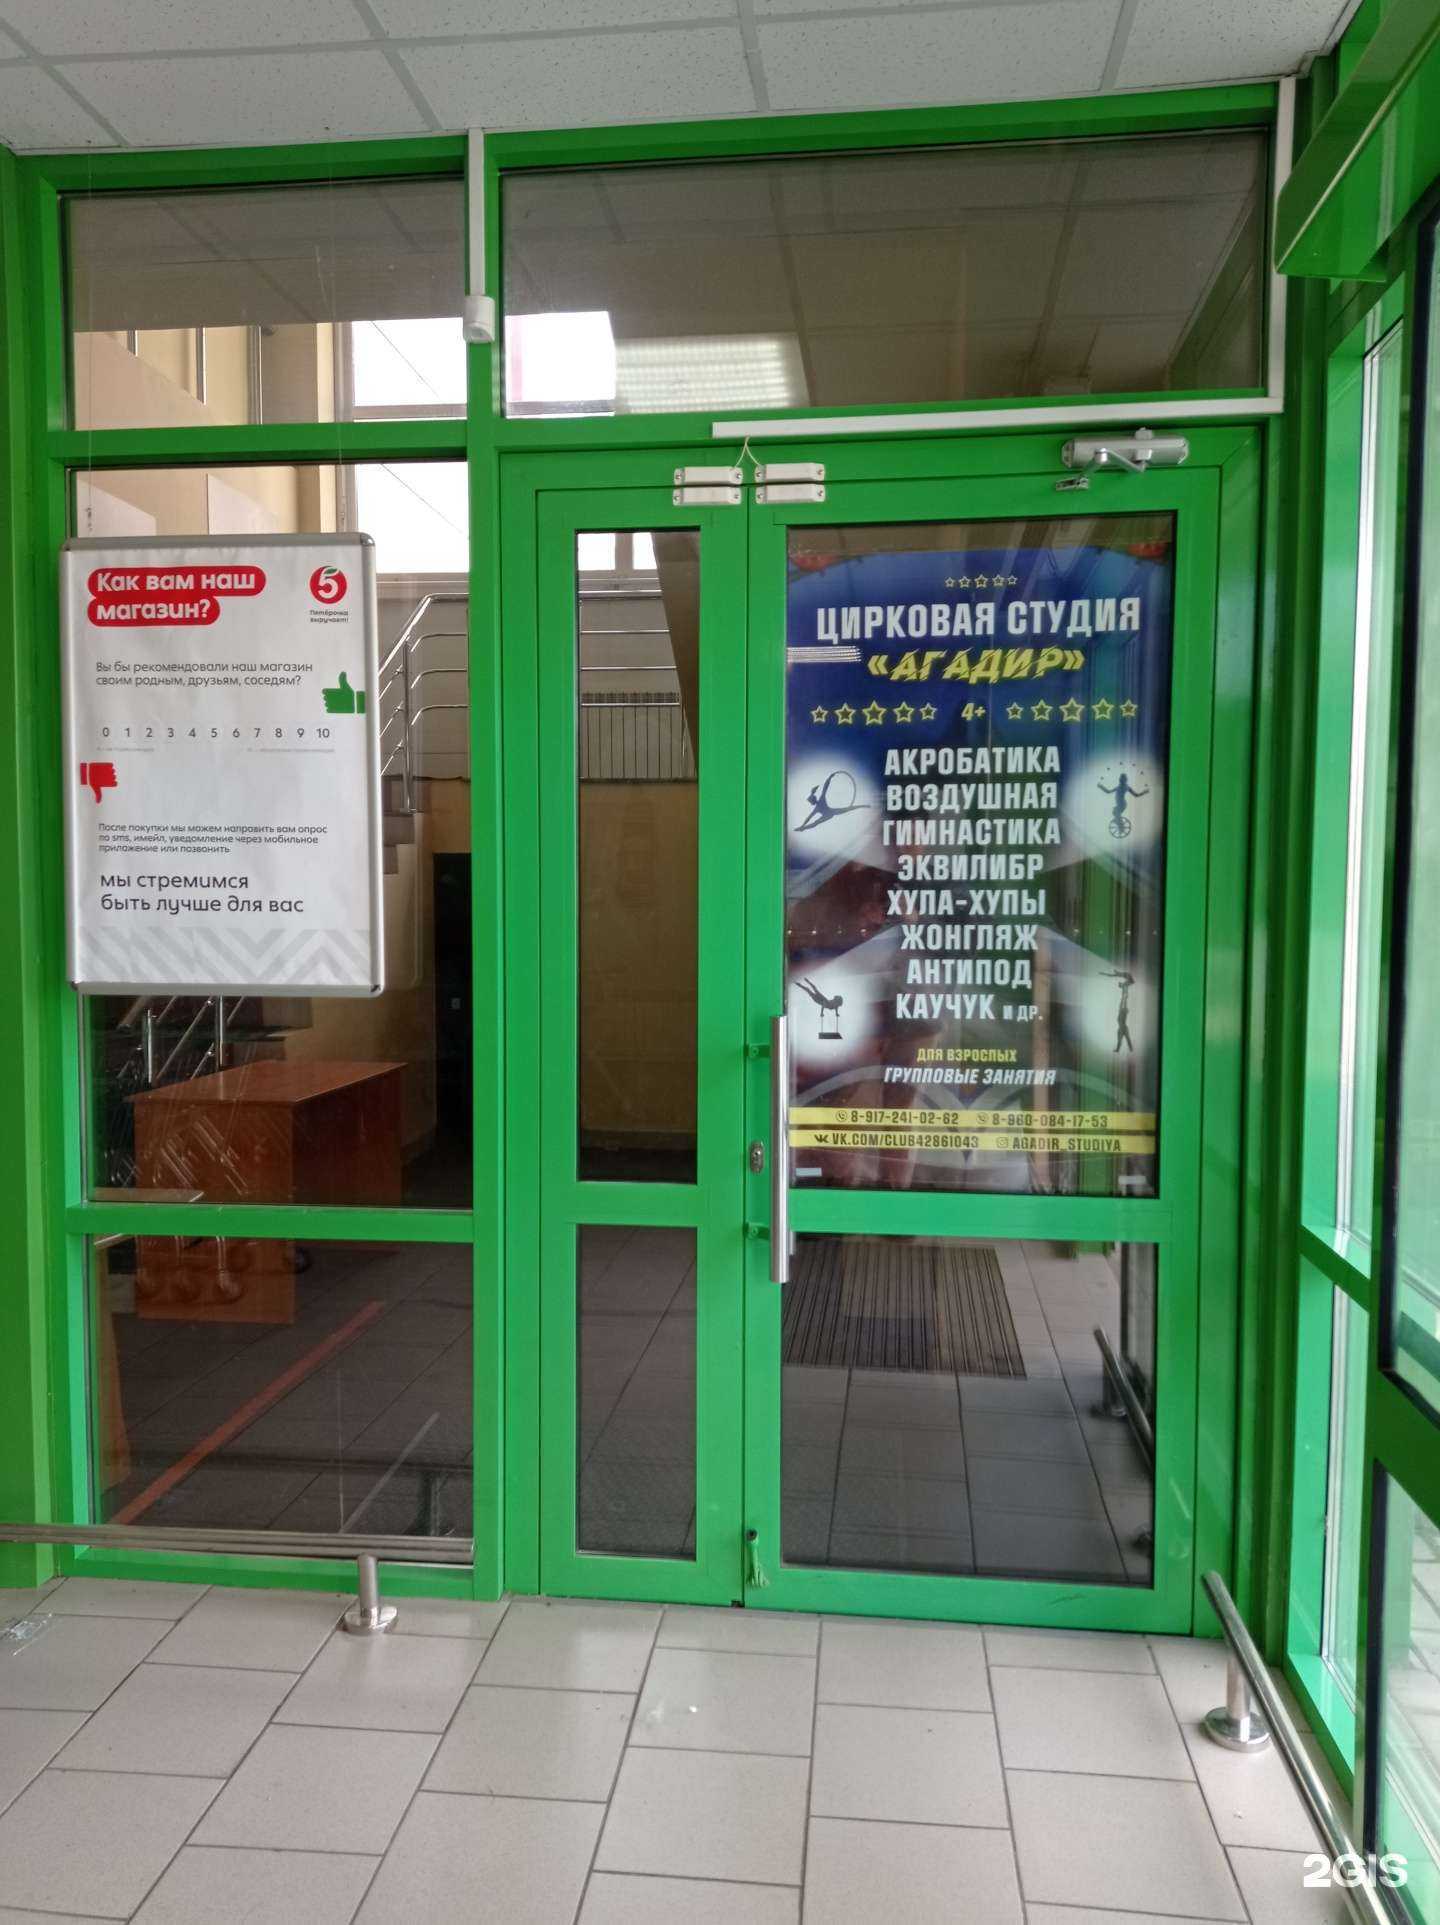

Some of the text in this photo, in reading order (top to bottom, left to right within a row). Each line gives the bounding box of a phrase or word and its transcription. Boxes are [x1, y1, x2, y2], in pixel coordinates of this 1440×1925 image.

[97, 573, 255, 591] Как вам наш
[97, 599, 210, 620] магазин?
[816, 596, 1141, 645] ЦИРКОВАЯ СТУДИЯ
[96, 661, 313, 674] Вы бы рекомендовали наш магазин
[96, 675, 301, 688] своим родным, друзьям, соседям?
[961, 702, 986, 721] 4+
[102, 728, 330, 738] 0 1 2 3 4 5 6 7 8 9 10
[884, 745, 1061, 776] АКРОБАТИКА
[886, 781, 1058, 814] ВОЗДУШНАЯ
[99, 823, 127, 832] После
[128, 825, 169, 833] покупки
[224, 825, 274, 834] направить
[298, 826, 328, 835] опрос
[882, 817, 1061, 846] ГИМНАСТИКА
[169, 836, 233, 844] уведомление
[235, 836, 262, 845] через
[264, 835, 319, 844] мобильное
[898, 853, 1044, 881] ЭКВИЛИБР
[100, 874, 249, 892] мы стремимся
[101, 894, 304, 916] быть лучше для вас
[886, 889, 1046, 916] ХУЛА-ХУПЫ
[900, 924, 1038, 951] ЖОНГЛЯЖ
[906, 958, 1033, 990] АНТИПОД
[896, 993, 996, 1020] КАУЧУК
[1016, 1005, 1044, 1022] ДР.
[916, 1048, 1018, 1063] ДЛЯ ВЗРОСЛЫХ
[884, 1067, 1057, 1086] ГРУППОВЫЕ ЗАНЯТИЯ
[850, 1110, 959, 1125] 8-917-241-02-62
[832, 1132, 979, 1148] VK.COM/CLUB42861043
[1012, 1137, 1121, 1152] AGADIR_STUDIYA
